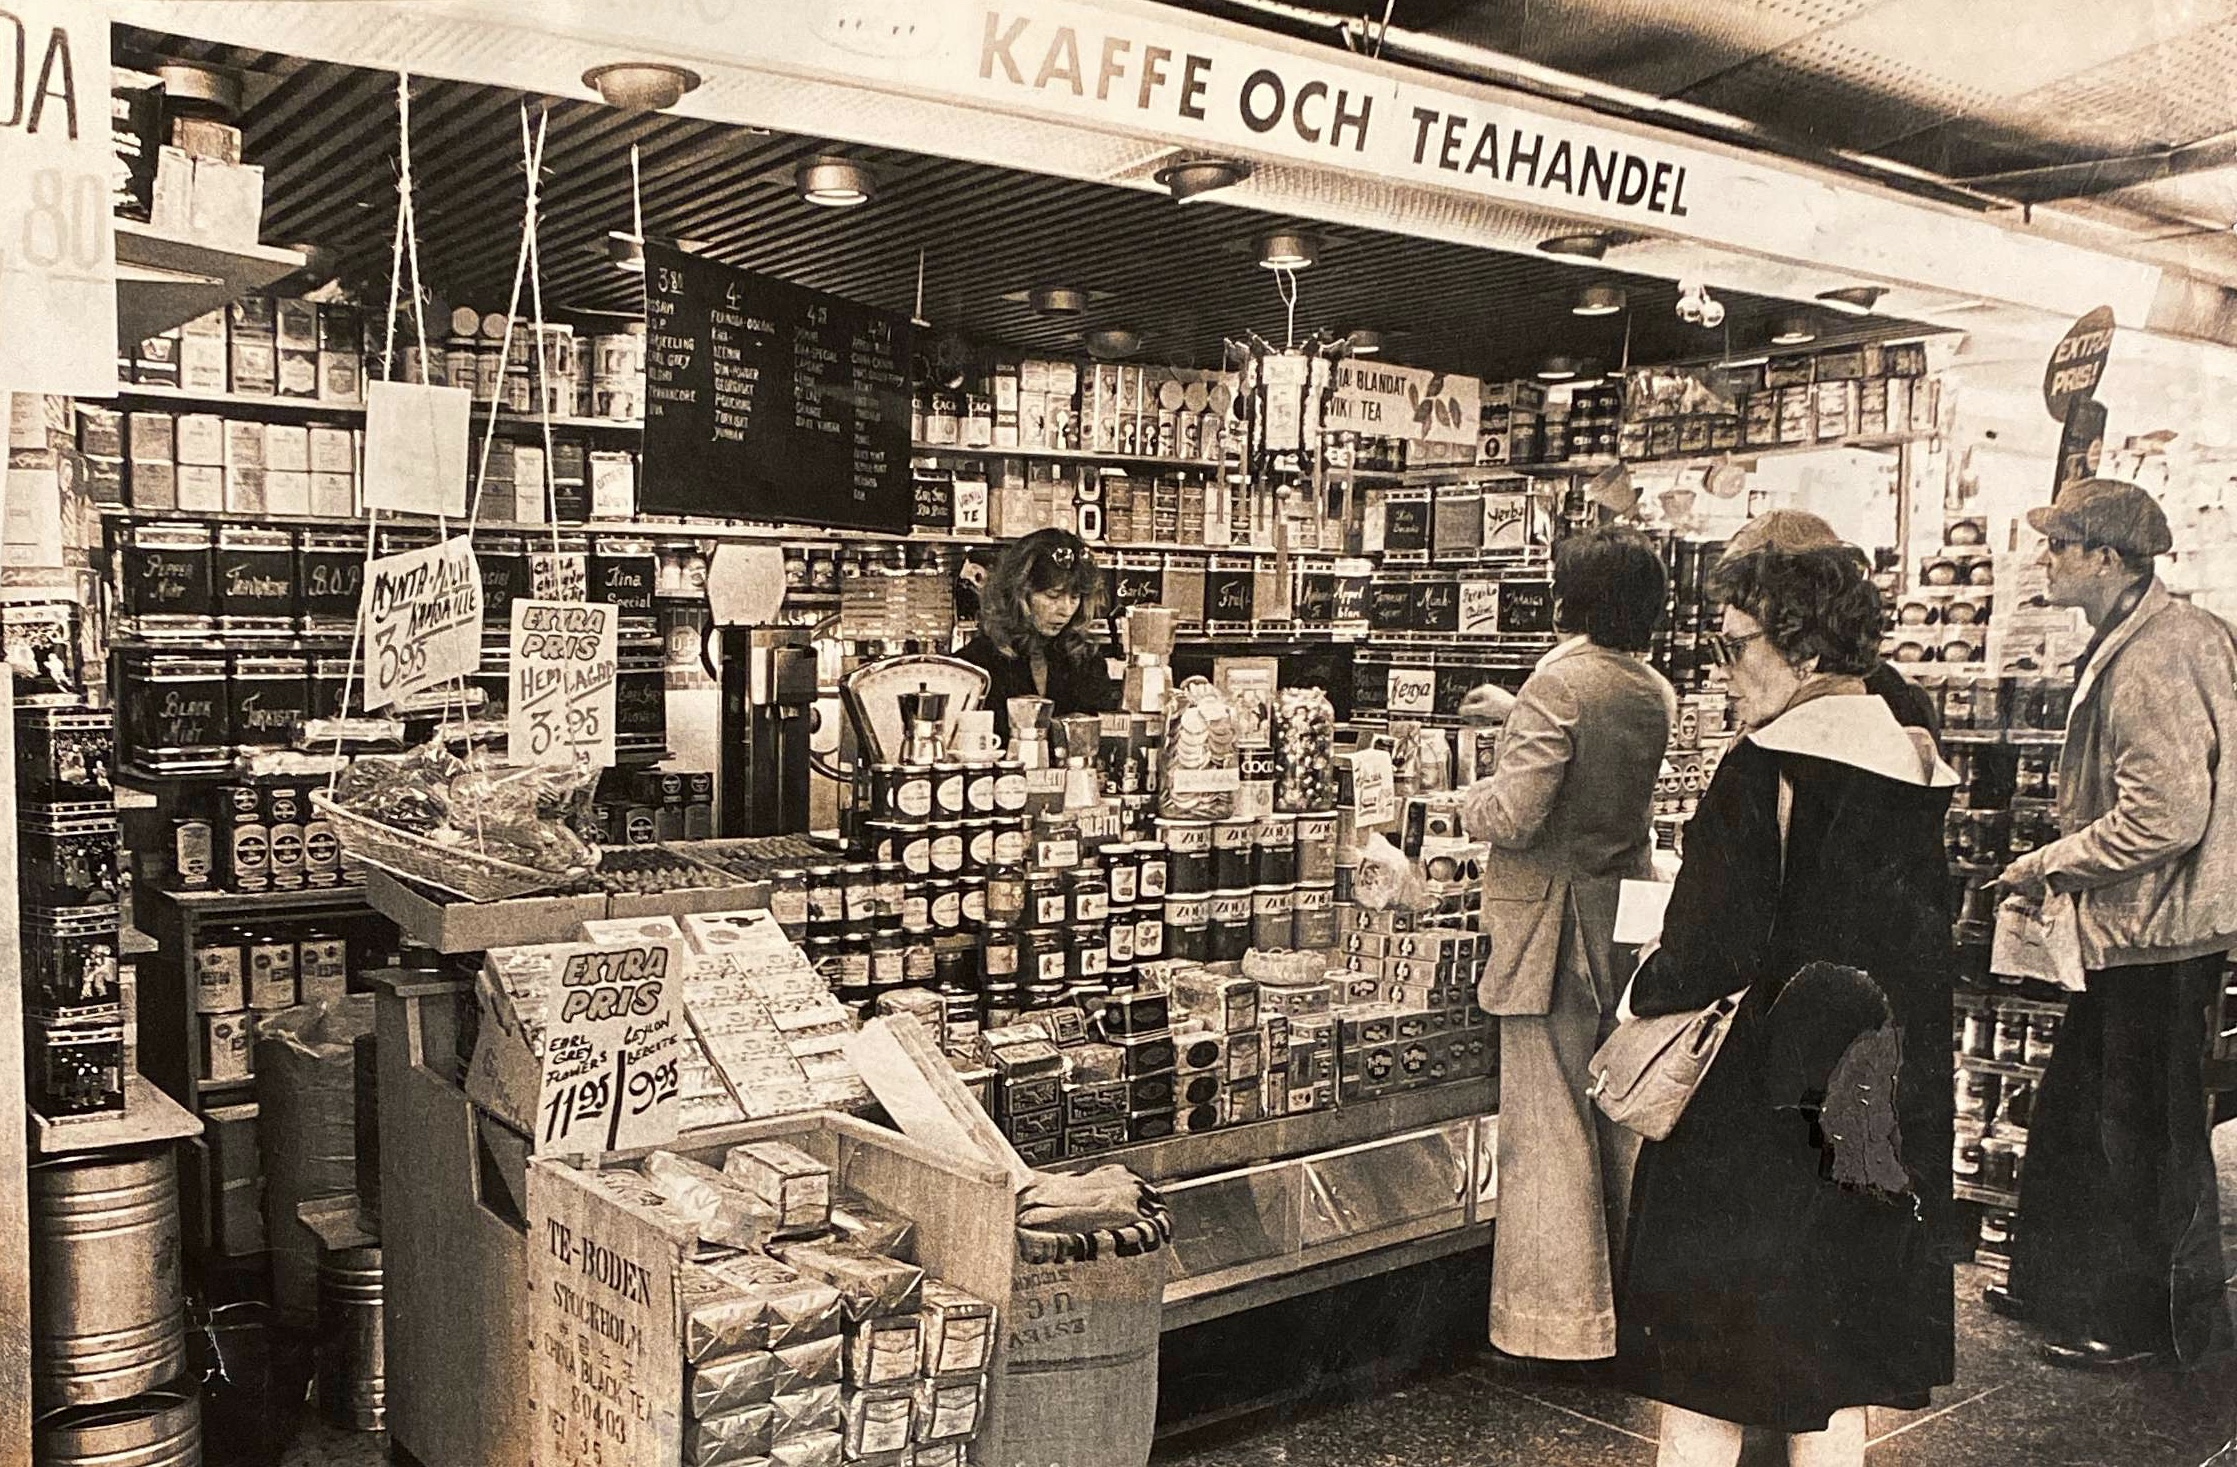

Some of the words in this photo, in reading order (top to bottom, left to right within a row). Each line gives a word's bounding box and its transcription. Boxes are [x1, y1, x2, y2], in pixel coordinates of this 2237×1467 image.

[978, 11, 1212, 121] KAFFE
[1239, 68, 1373, 152] OCH
[1412, 106, 1689, 217] TEAHANDEL
[2054, 328, 2114, 364] EXTRA
[1356, 370, 1407, 398] BLANDAT
[1361, 400, 1382, 422] TEA
[962, 510, 980, 523] TE
[522, 606, 606, 634] EXTRA
[521, 633, 600, 661] PRIS
[561, 945, 669, 988] EXTRA
[561, 980, 663, 1024] PRIS
[548, 1034, 592, 1052] EARL
[552, 1043, 594, 1066] GREY
[546, 1216, 652, 1310] TE-BODEN
[553, 1281, 644, 1358] STOCKHOLM
[581, 1359, 623, 1408] BLACK
[627, 1388, 655, 1431] TEA
[571, 1385, 626, 1446] 80403
